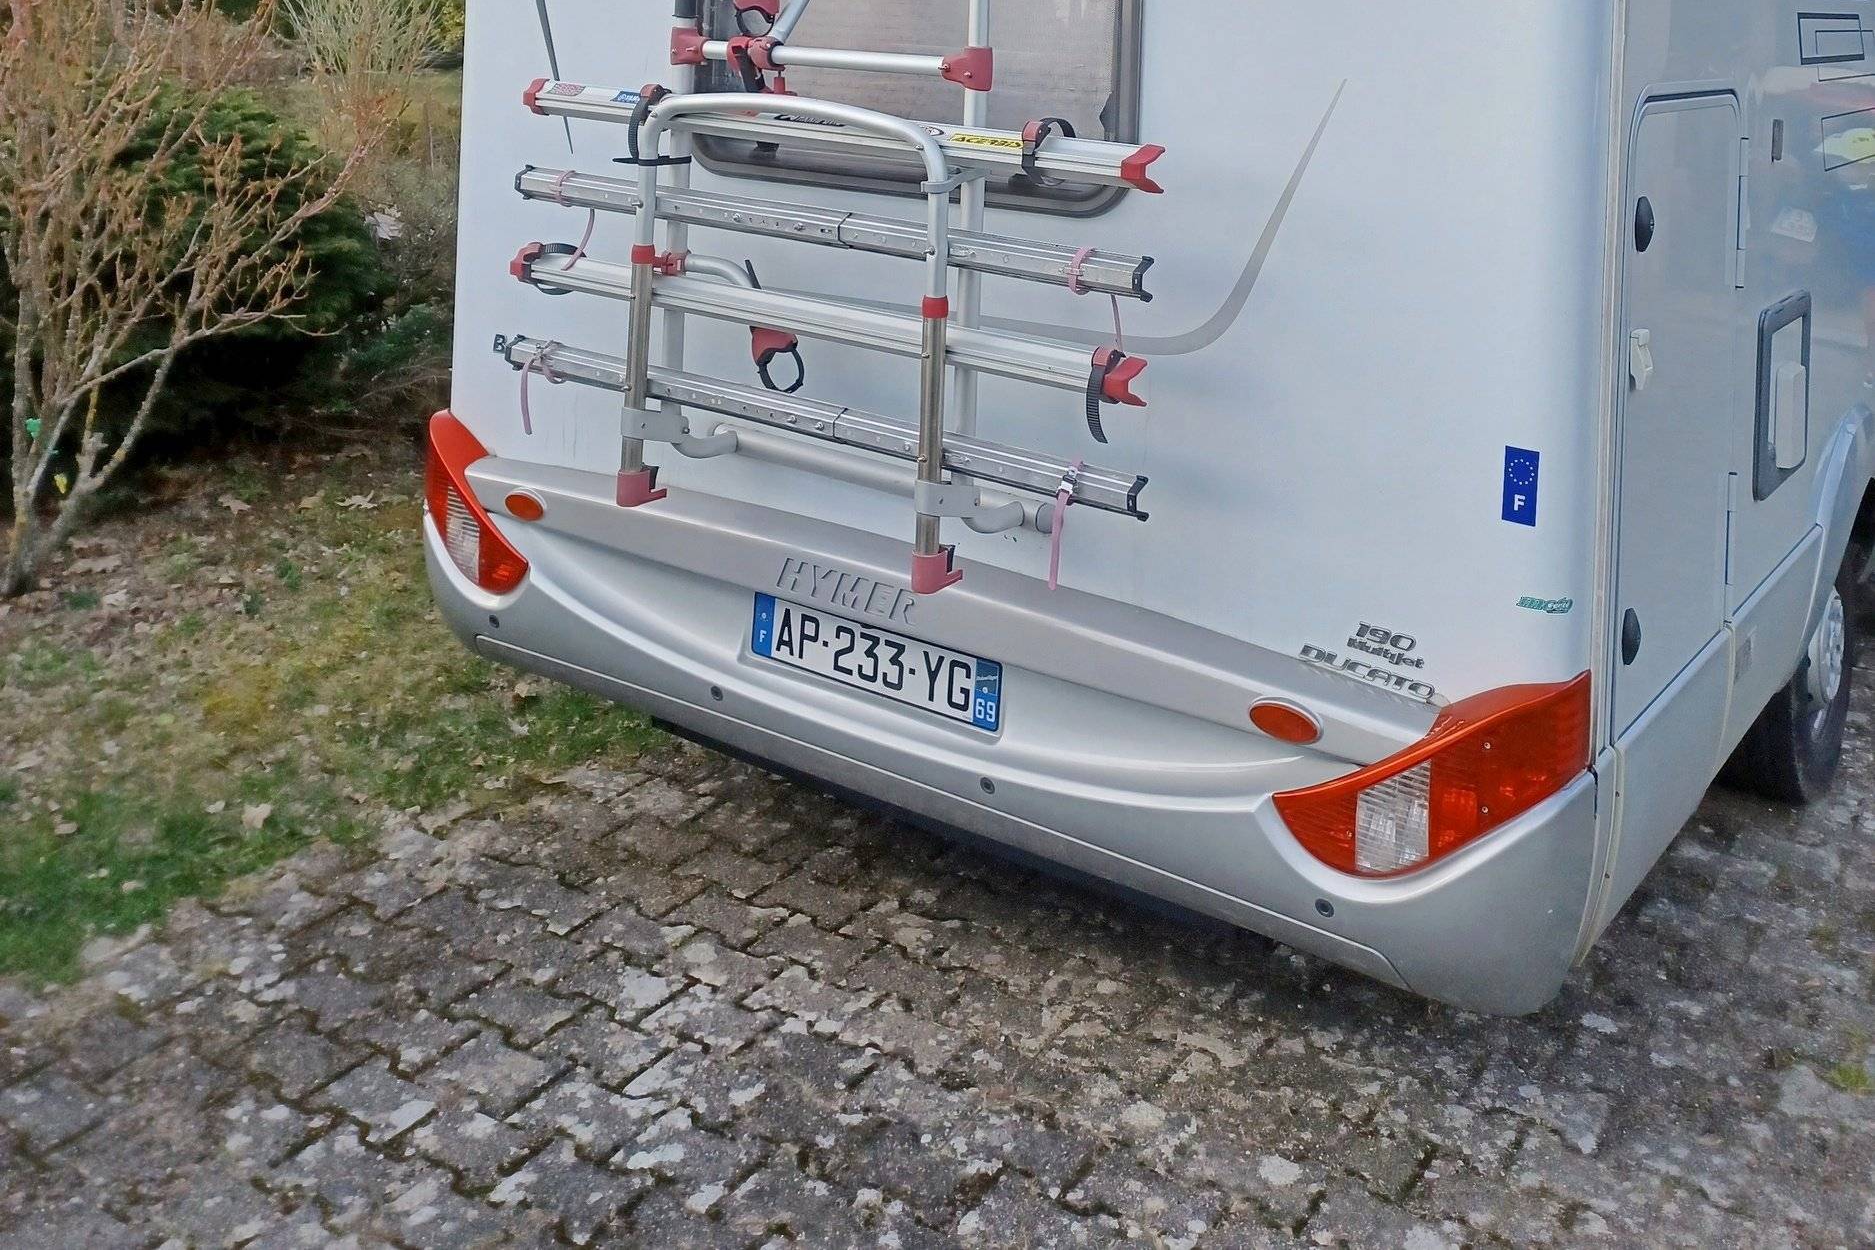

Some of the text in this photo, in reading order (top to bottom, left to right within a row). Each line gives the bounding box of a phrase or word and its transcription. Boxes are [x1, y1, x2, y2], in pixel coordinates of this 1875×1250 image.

[1513, 494, 1526, 511] F
[776, 557, 918, 626] HYMER
[759, 629, 768, 642] F
[1356, 621, 1416, 651] 190
[775, 607, 971, 712] AP-233-YG
[1299, 644, 1435, 699] DUCATO
[975, 697, 996, 723] 69
